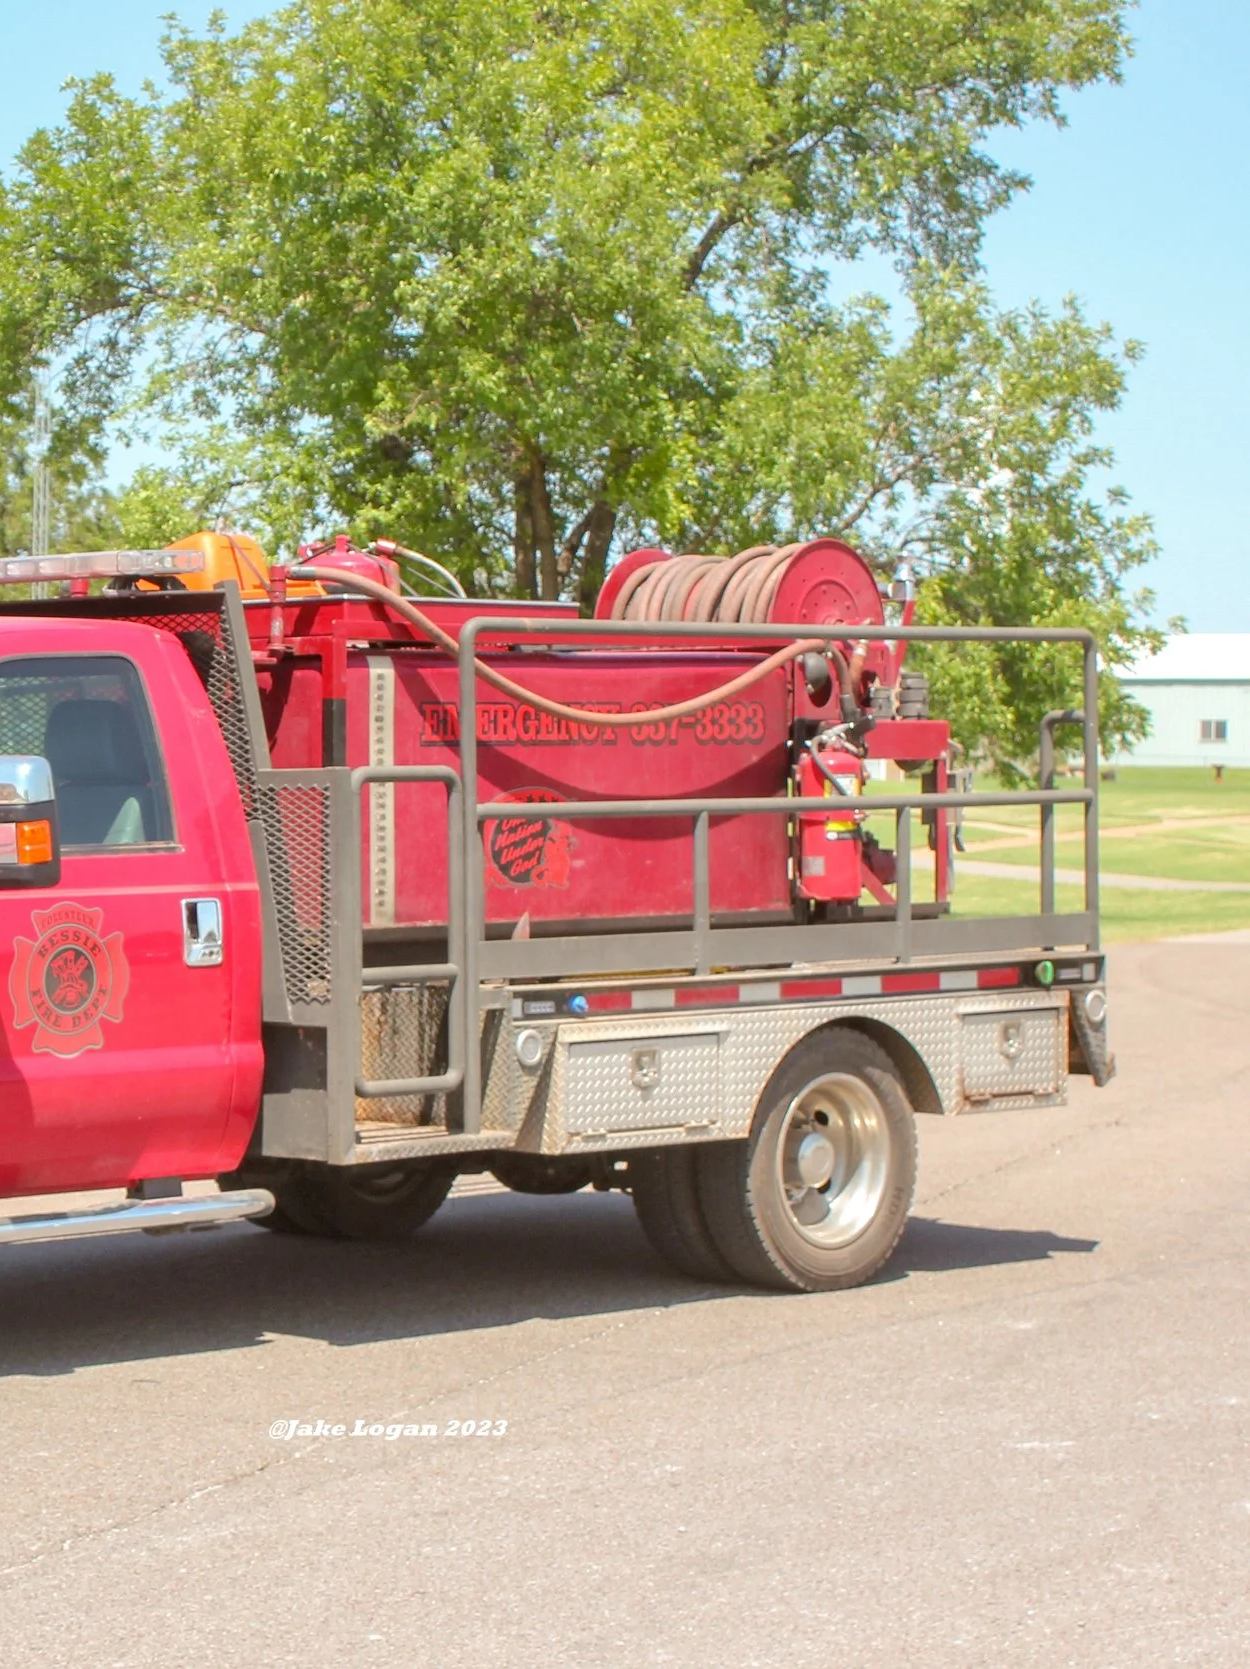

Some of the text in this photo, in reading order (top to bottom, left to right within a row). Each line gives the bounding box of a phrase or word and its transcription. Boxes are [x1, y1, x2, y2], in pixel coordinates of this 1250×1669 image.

[494, 820, 543, 852] Nation
[500, 837, 545, 865] Under
[510, 851, 540, 877] God
[37, 930, 101, 958] BESSIE
[32, 984, 107, 1029] FIRE DEPT
